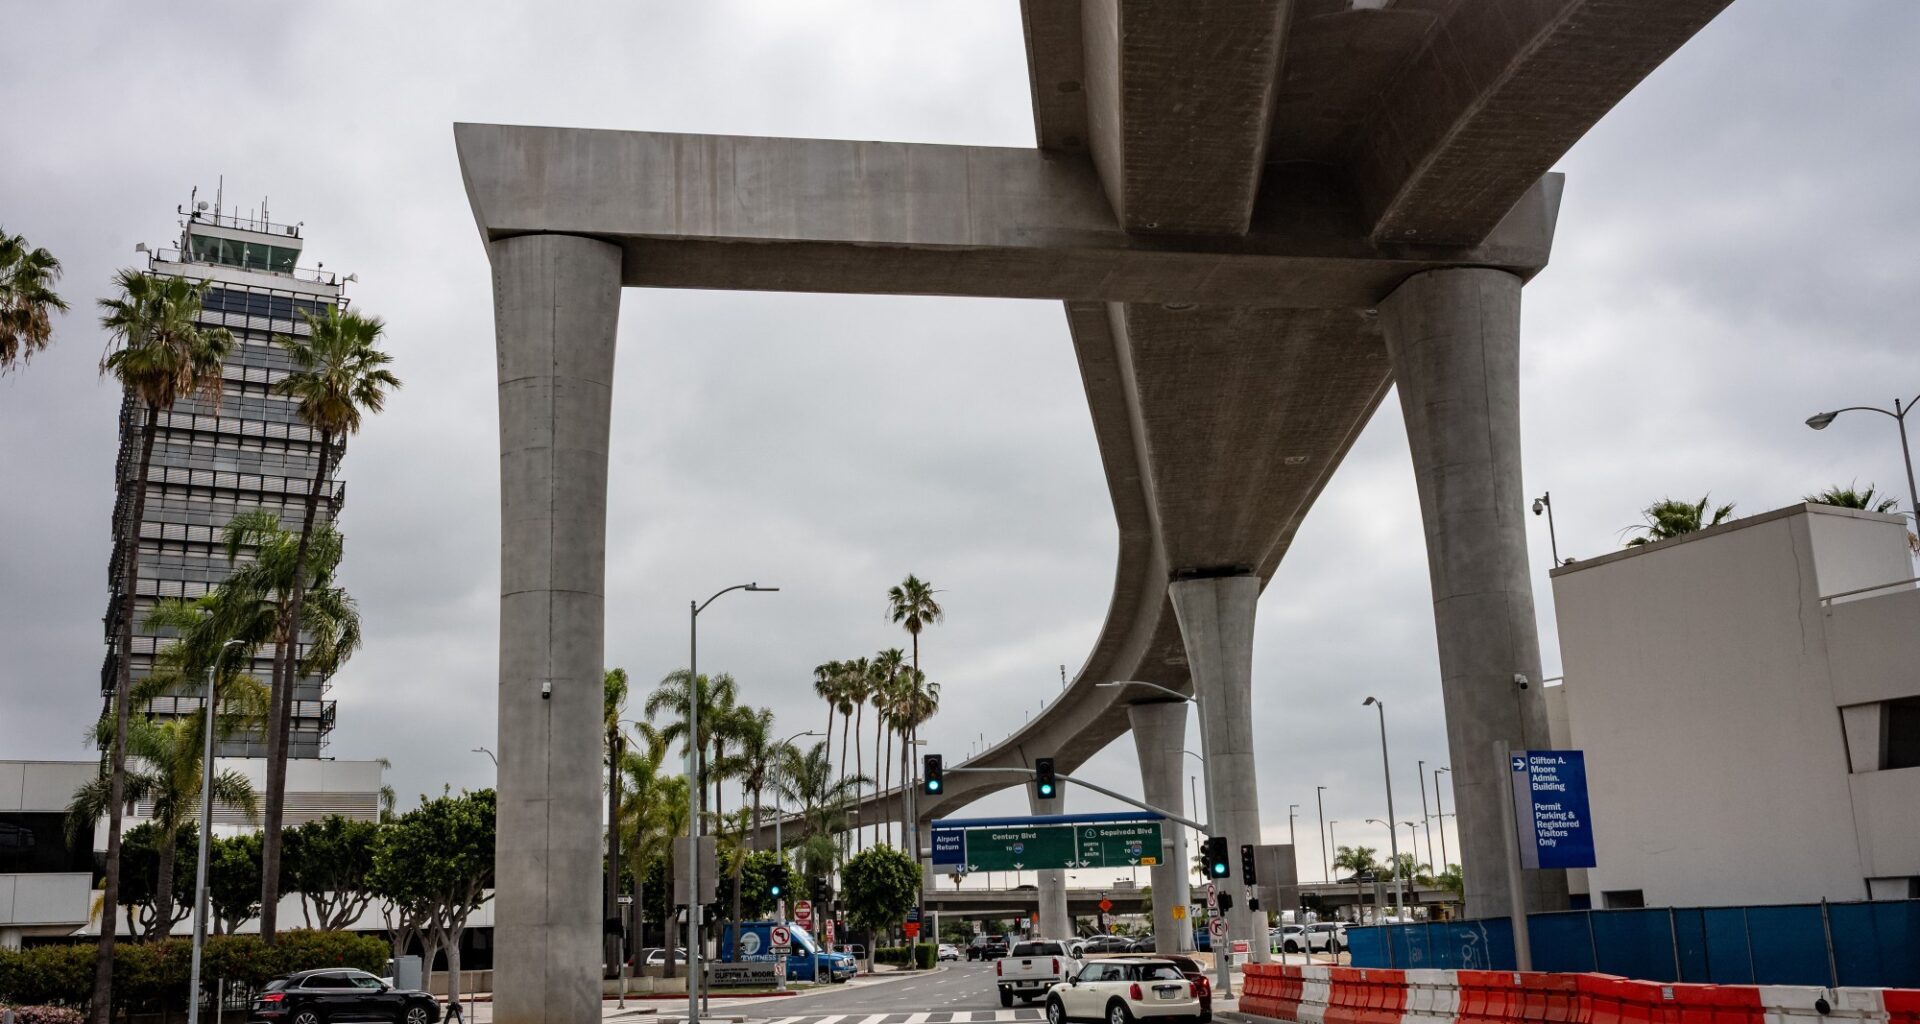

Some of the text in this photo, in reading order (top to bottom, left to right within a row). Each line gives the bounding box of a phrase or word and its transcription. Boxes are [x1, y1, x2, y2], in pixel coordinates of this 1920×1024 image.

[1530, 756, 1566, 764] Clifton A.
[1533, 783, 1565, 791] Building
[1536, 812, 1566, 820] Parking
[1537, 820, 1579, 829] Registered
[1100, 828, 1136, 836] Sepulveda
[1539, 838, 1556, 847] Only
[752, 970, 776, 978] MOORE
